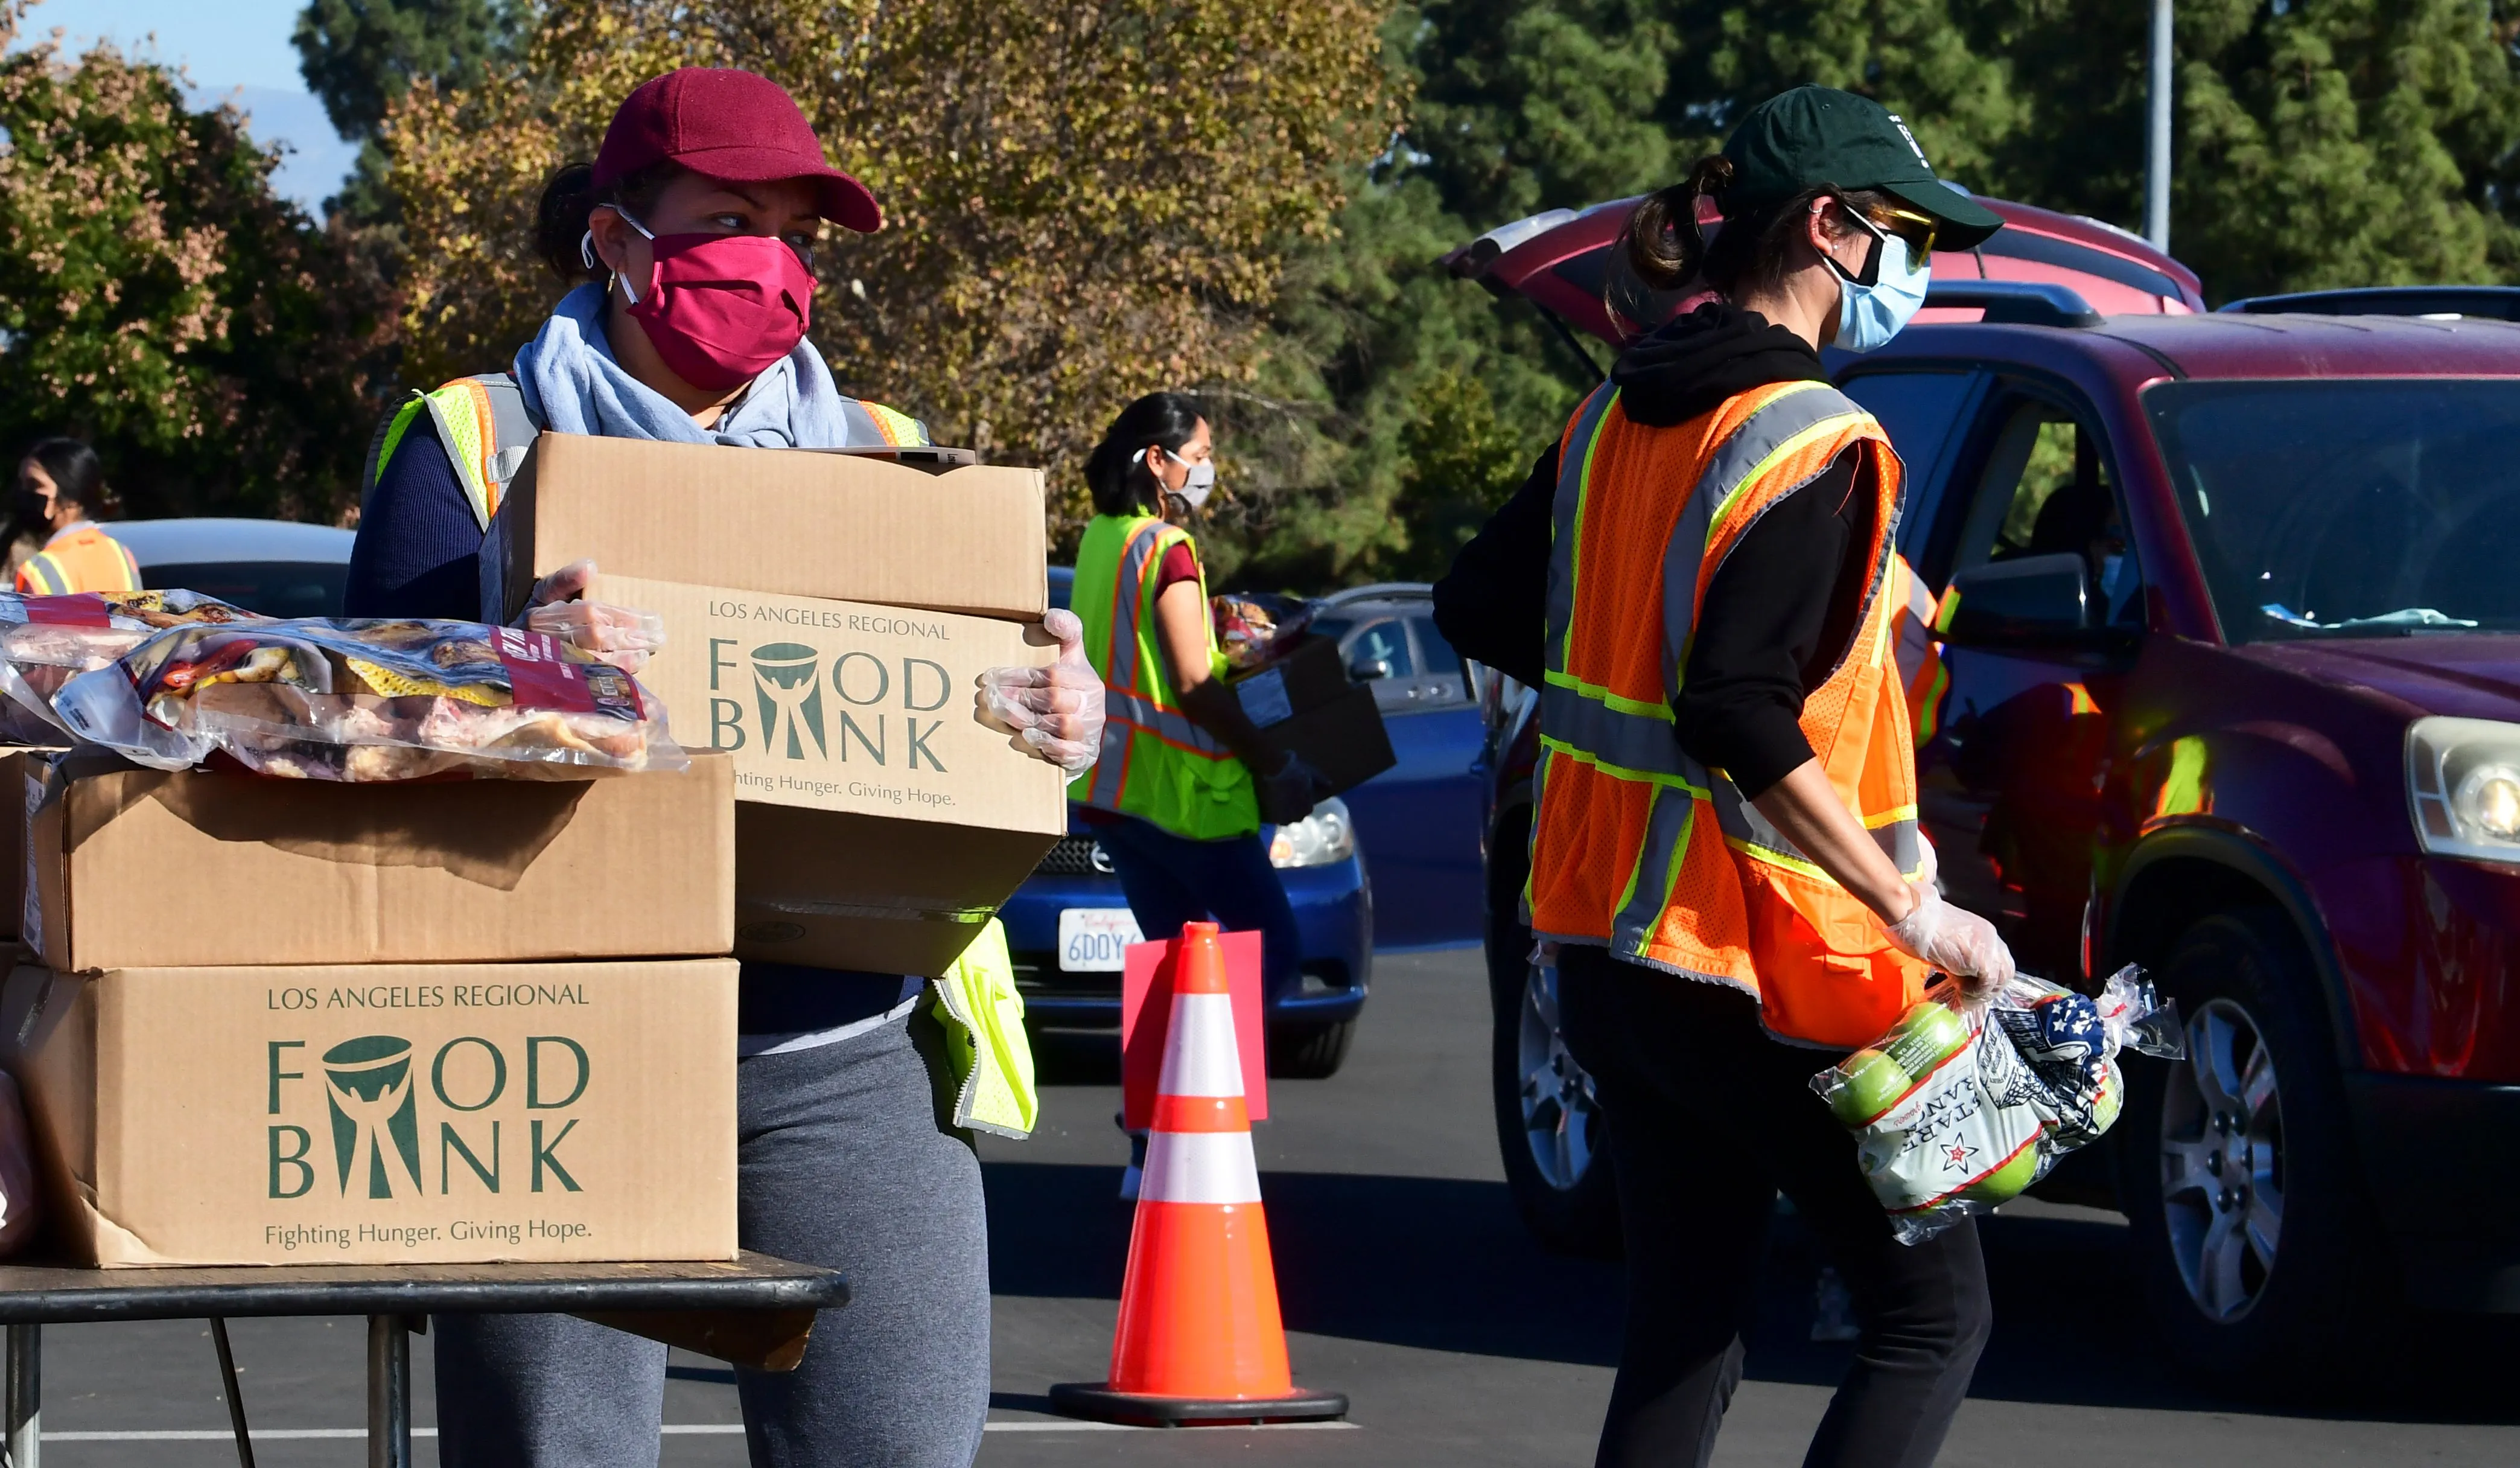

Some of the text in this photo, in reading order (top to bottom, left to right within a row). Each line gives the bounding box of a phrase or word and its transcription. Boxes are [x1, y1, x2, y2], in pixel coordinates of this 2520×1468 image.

[710, 601, 950, 640] LOS ANGELES REGIONAL
[734, 770, 956, 808] hting Hunger. Giving Hope.
[268, 984, 590, 1010] LOS ANGELES REGIONAL
[266, 1219, 592, 1250] Fighting Hunger. Giving Hope.
